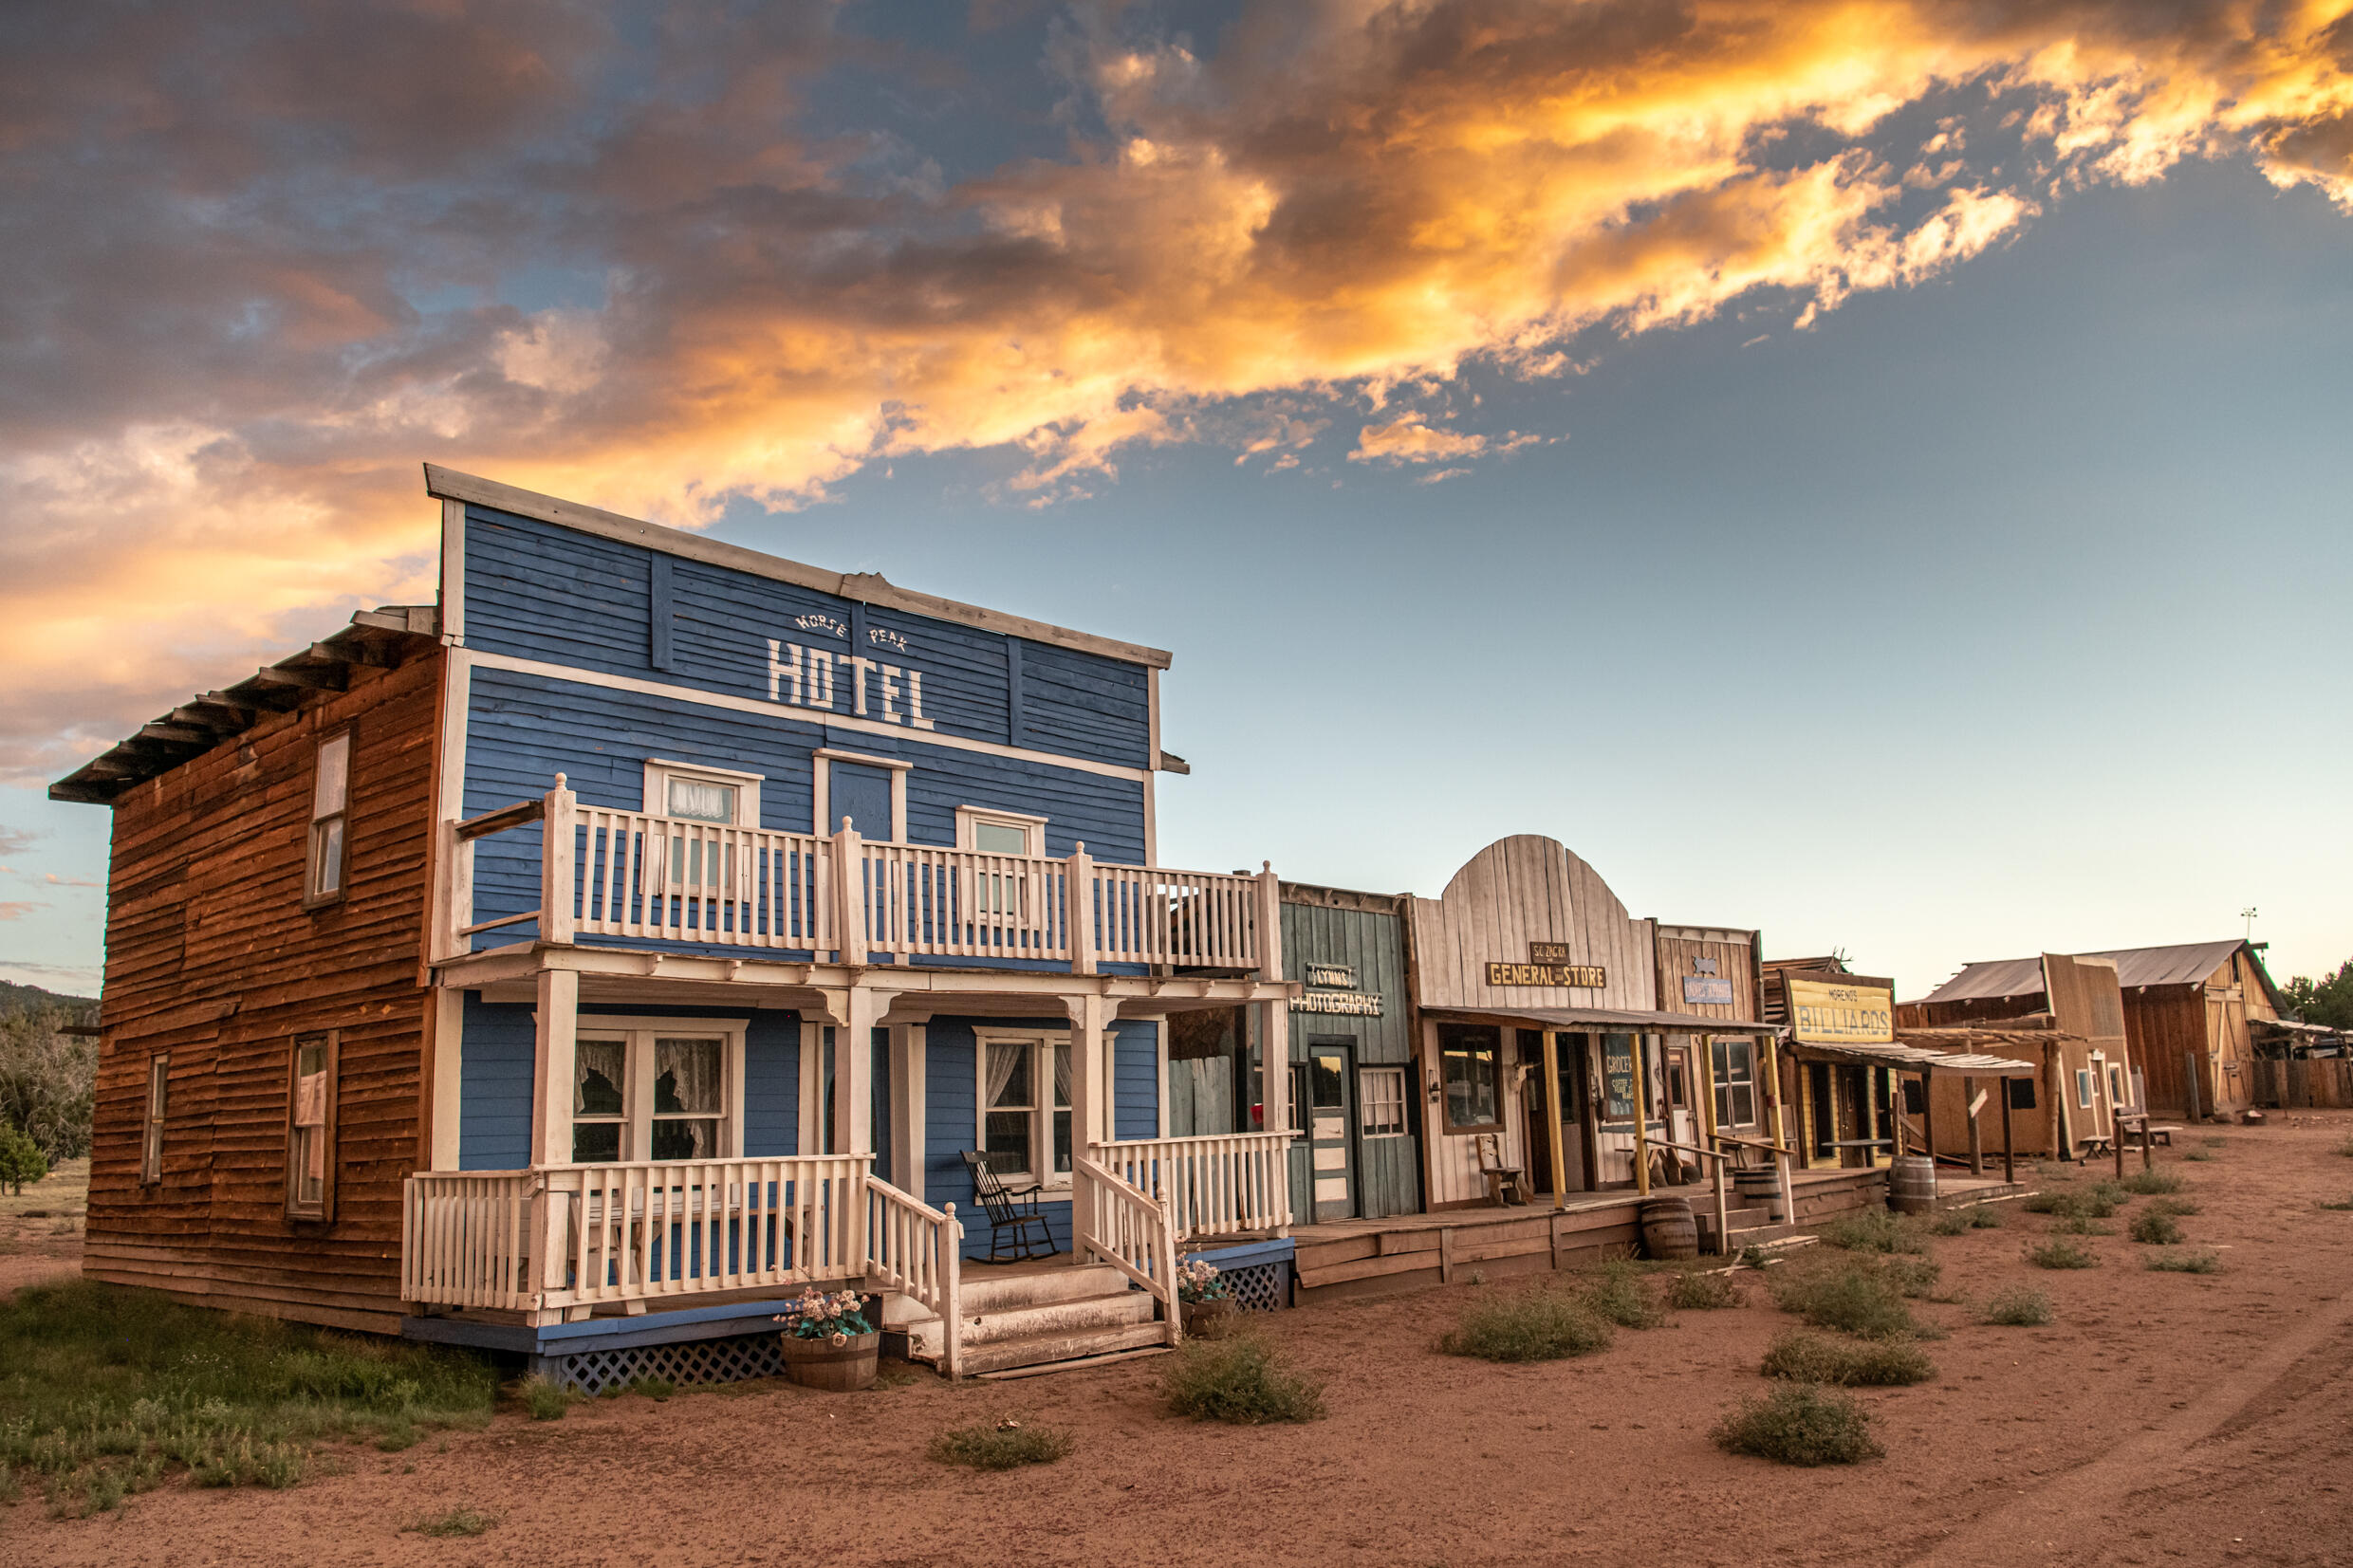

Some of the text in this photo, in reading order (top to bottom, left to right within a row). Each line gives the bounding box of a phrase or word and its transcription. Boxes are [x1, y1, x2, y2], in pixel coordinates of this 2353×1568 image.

[795, 615, 908, 653] HORSE PEAK
[767, 638, 936, 730] HOTEL
[1490, 963, 1603, 987] GENERAL STORE
[1289, 992, 1380, 1016] PHOTOGRAPHY
[1799, 1005, 1889, 1036] BILLIARDS
